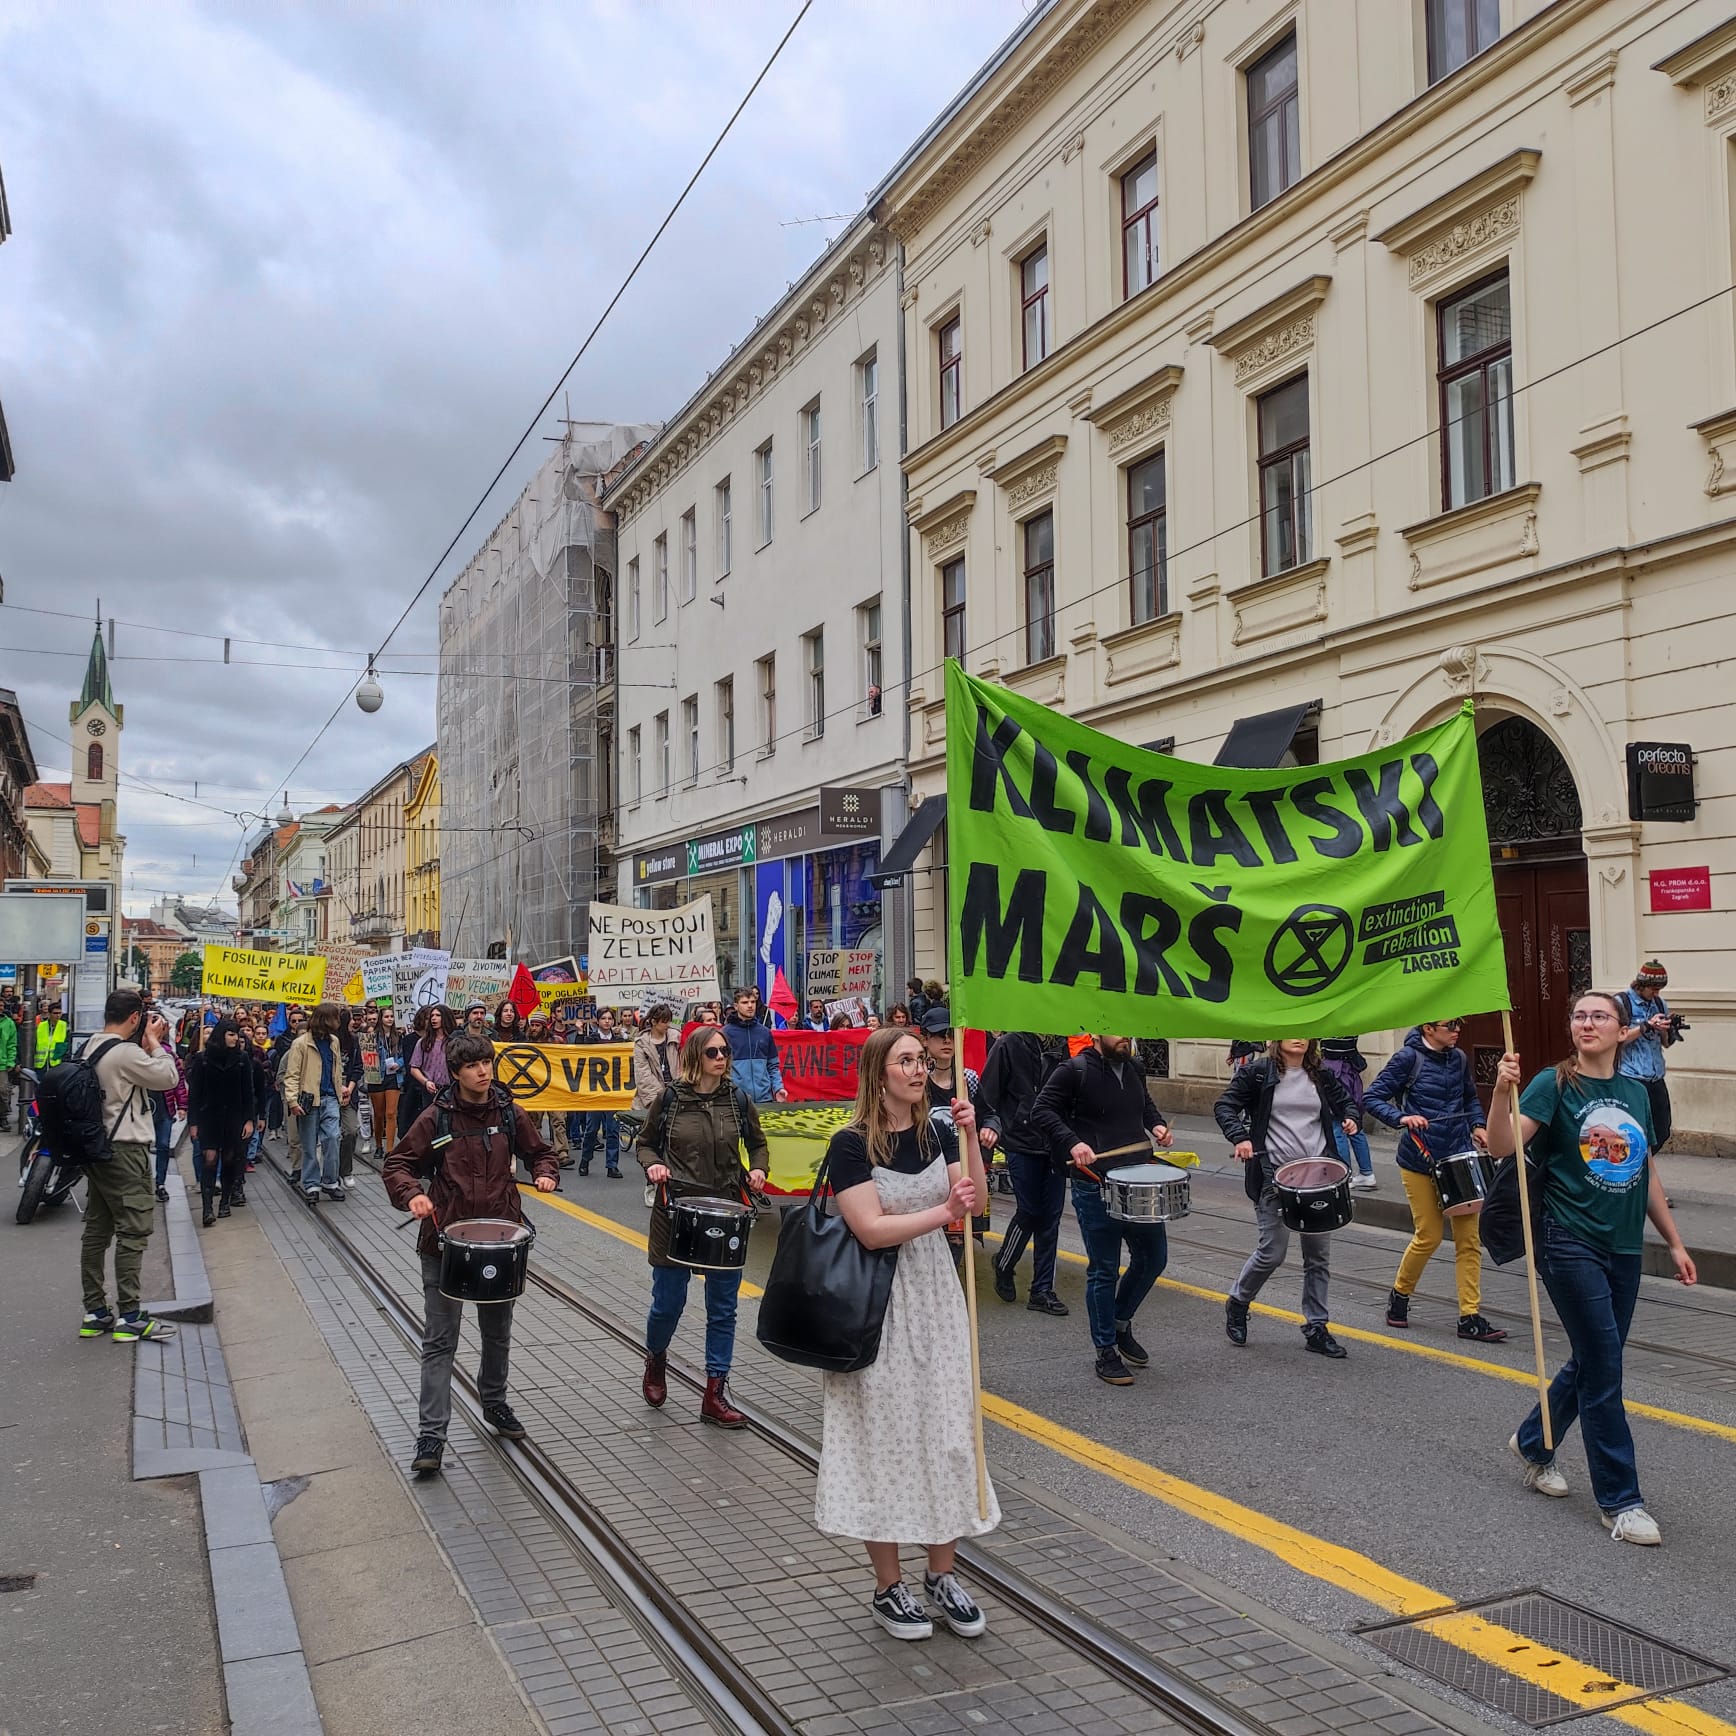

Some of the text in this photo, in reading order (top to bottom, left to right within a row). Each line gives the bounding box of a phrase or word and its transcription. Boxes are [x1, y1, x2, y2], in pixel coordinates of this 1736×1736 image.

[1638, 747, 1686, 764] perfecta
[1648, 761, 1690, 775] dreams
[970, 706, 1443, 867] KLIMATSKI
[829, 815, 873, 823] HERALDI
[773, 826, 806, 843] HERALDI
[698, 834, 743, 860] MINERAL EXPO
[1364, 898, 1436, 932] extinction
[589, 913, 705, 935] NE POSTOJI
[961, 862, 1242, 1002] MARŠ
[602, 936, 693, 959] ZELENI
[1382, 923, 1453, 956] rebellion
[318, 945, 346, 955] UZGOJ
[848, 952, 874, 963] STOP
[222, 951, 308, 971] FOSILNI PLIN
[330, 955, 358, 965] HRANU
[813, 952, 839, 967] STOP
[1400, 951, 1460, 974] ZAGREB
[588, 964, 715, 984] KAPITALIZAM
[809, 969, 841, 980] CLIMATE
[848, 964, 872, 975] MEAT
[207, 972, 317, 996] KLIMATSKA KRIZA
[395, 983, 408, 993] THE
[468, 979, 500, 995] VEGANI
[680, 986, 701, 998] net
[808, 984, 840, 996] CHANGE
[849, 979, 872, 993] DAIRY
[562, 1003, 597, 1021] JUČER
